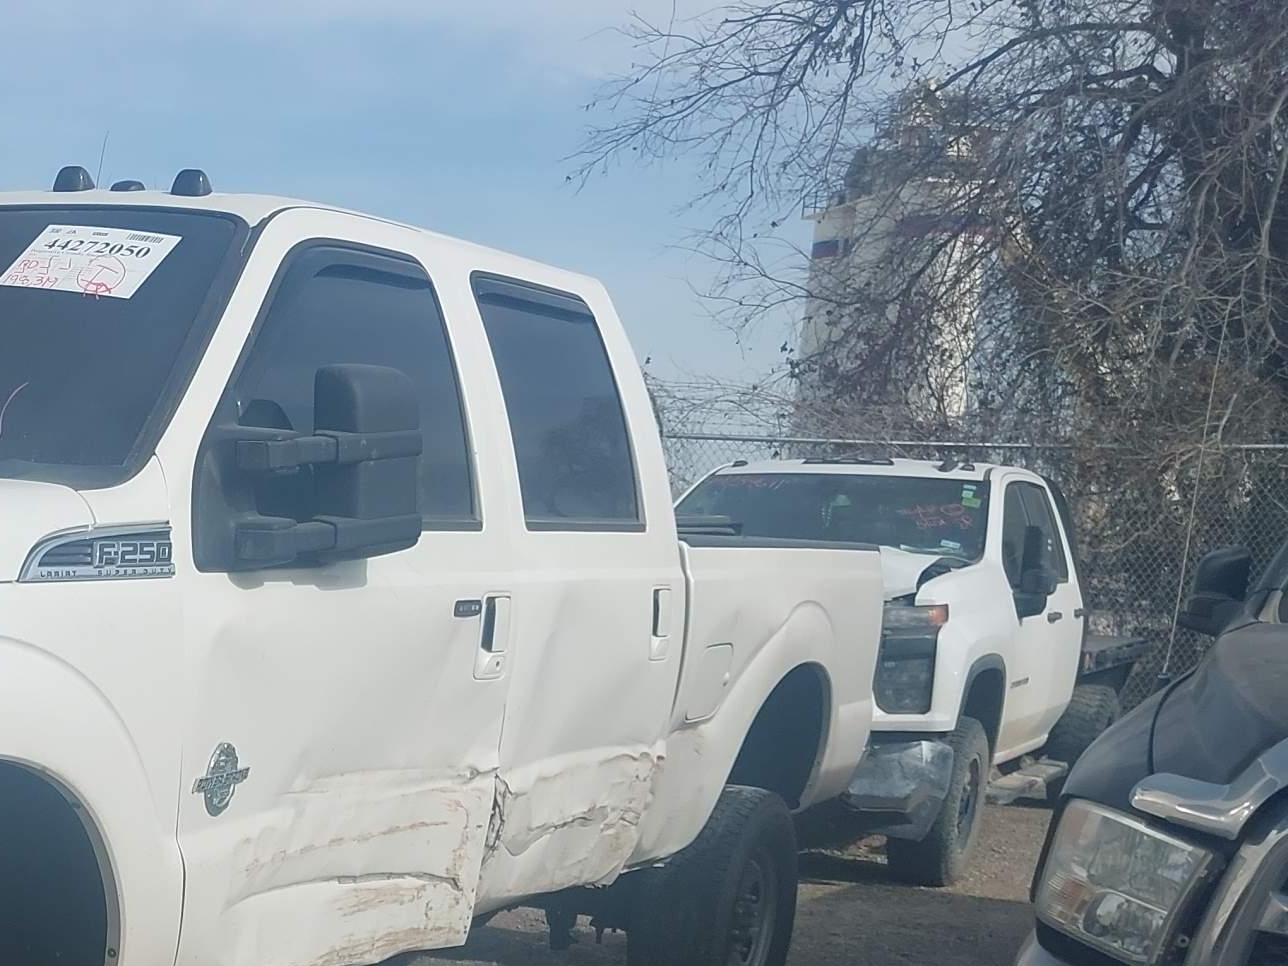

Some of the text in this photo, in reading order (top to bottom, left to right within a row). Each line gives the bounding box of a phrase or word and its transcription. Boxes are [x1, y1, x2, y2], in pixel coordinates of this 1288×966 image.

[43, 238, 151, 259] 44272050
[96, 541, 172, 567] F-250
[39, 567, 173, 578] LARIAT SUPER DUTY
